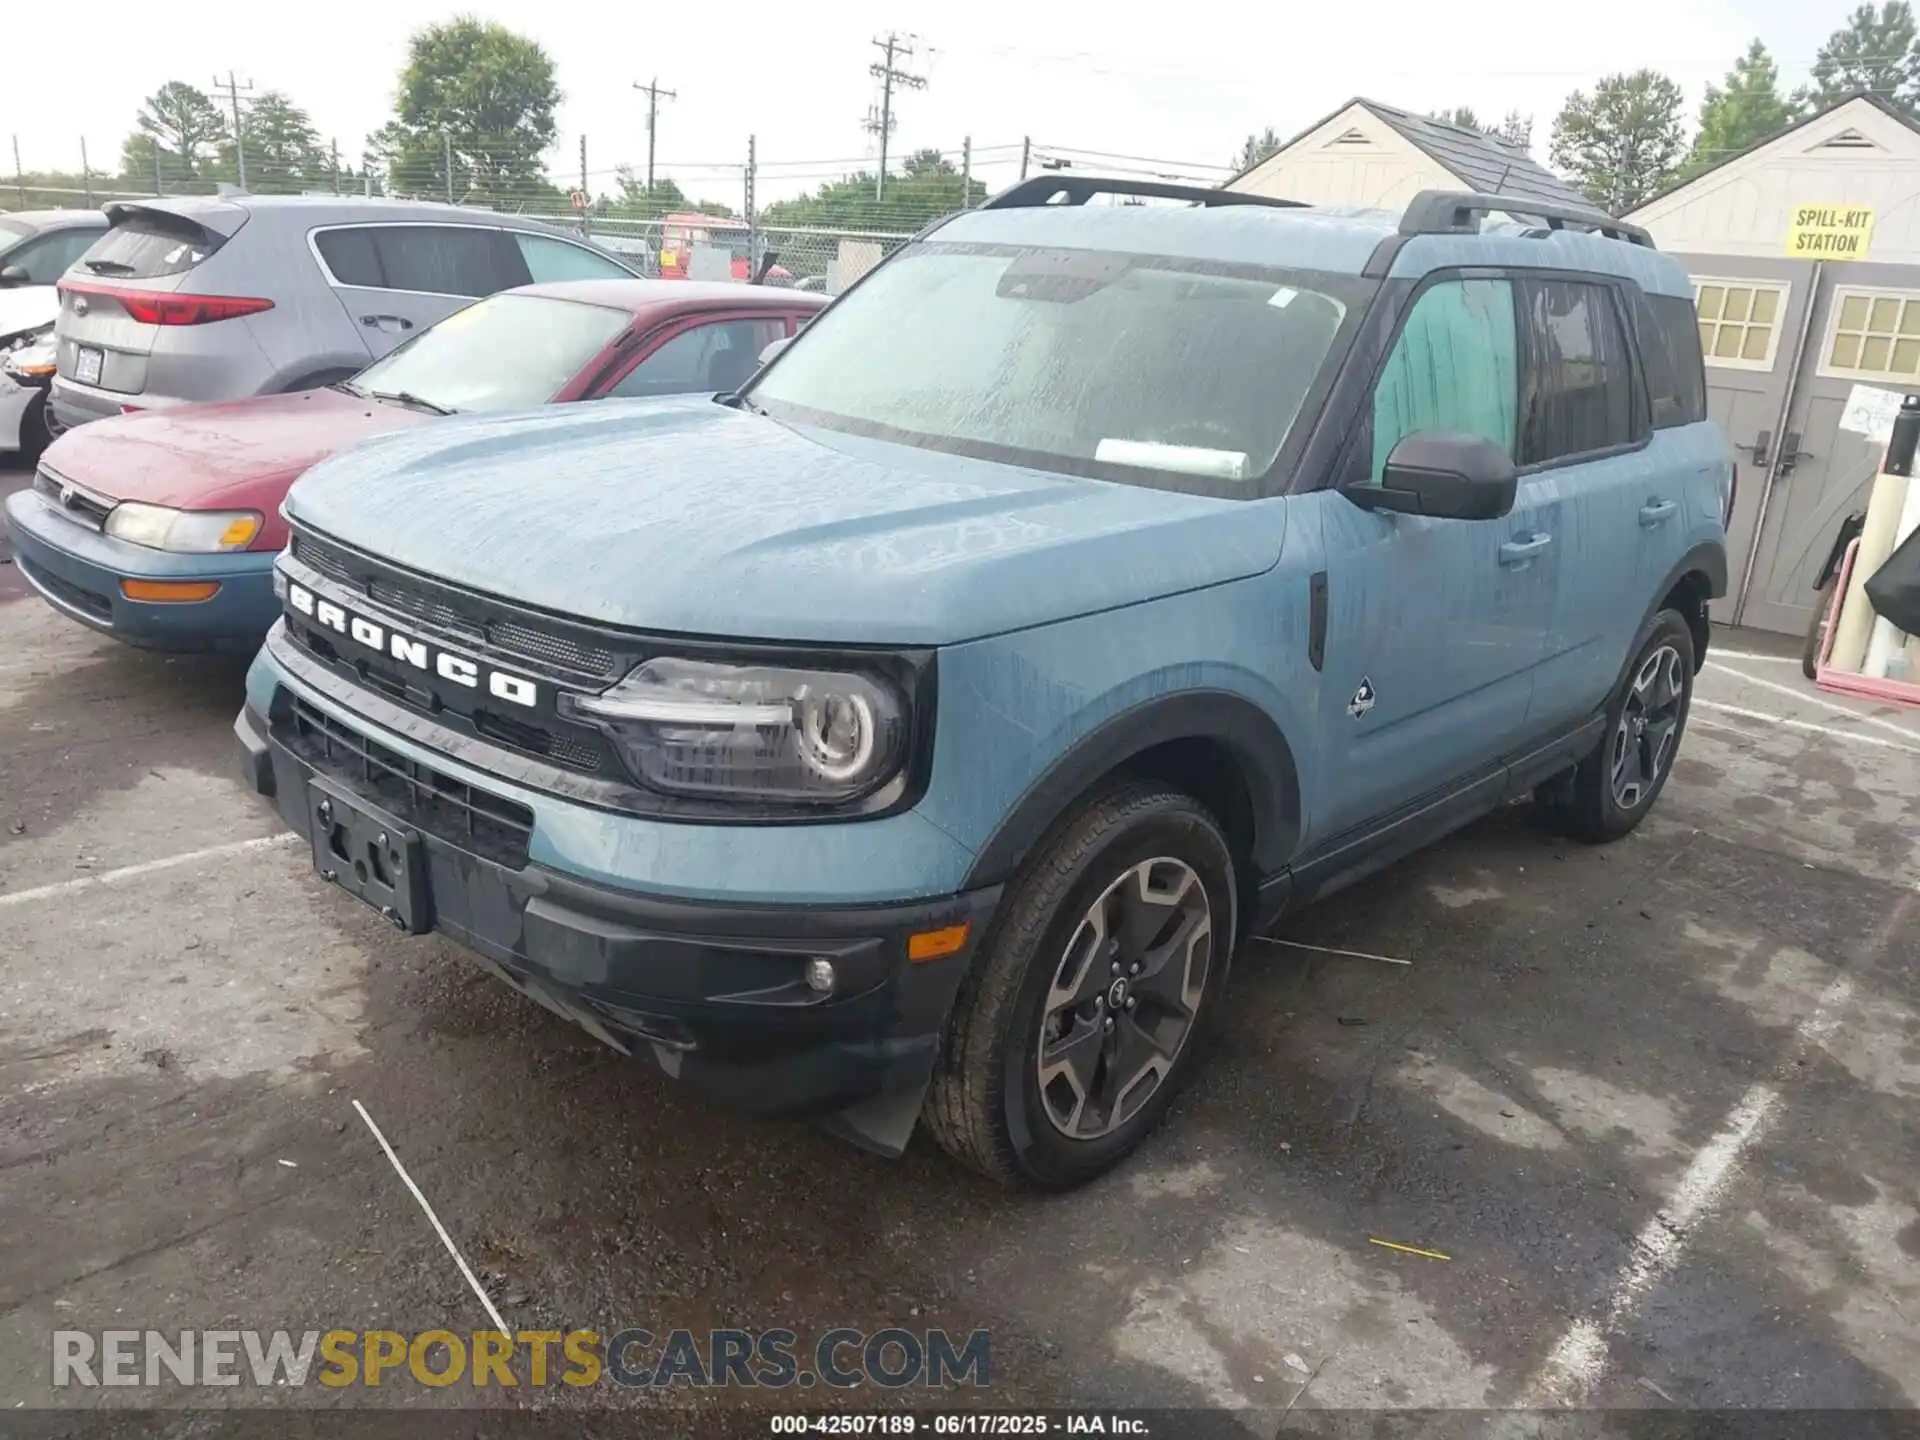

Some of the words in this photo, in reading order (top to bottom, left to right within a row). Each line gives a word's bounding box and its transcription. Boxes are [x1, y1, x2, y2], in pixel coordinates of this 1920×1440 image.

[1796, 209, 1871, 228] SPILL-KIT
[1796, 233, 1859, 252] STATION
[289, 583, 537, 708] BRONCO
